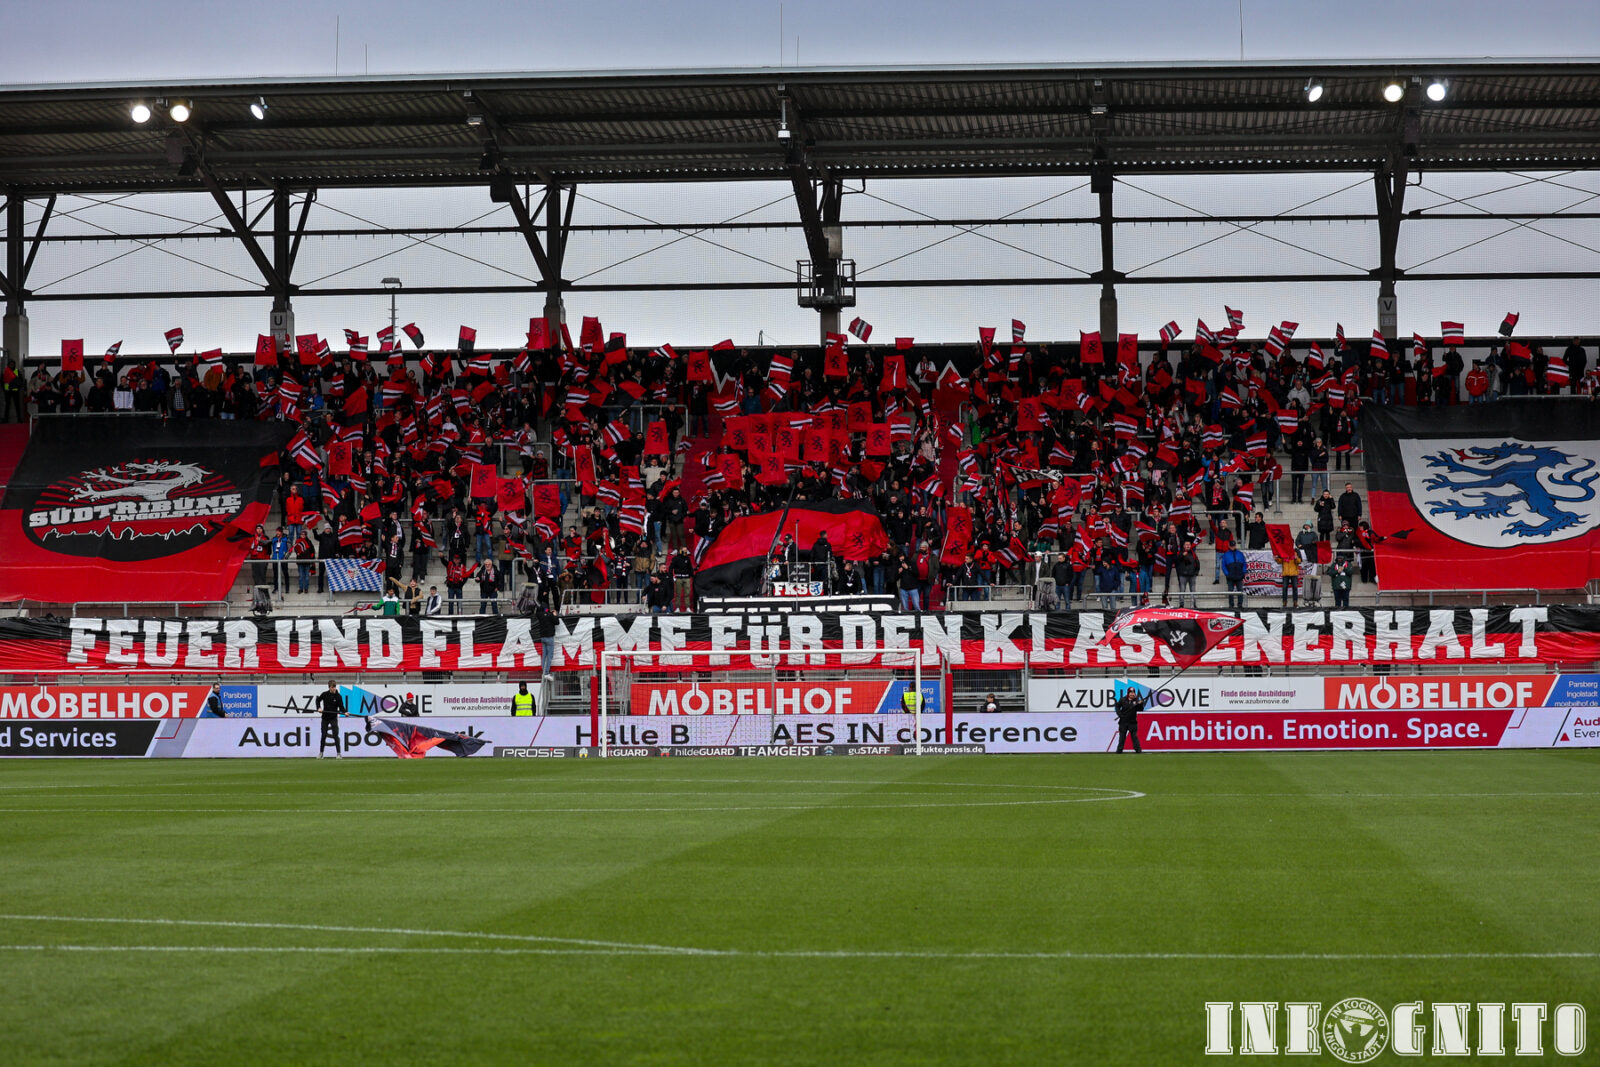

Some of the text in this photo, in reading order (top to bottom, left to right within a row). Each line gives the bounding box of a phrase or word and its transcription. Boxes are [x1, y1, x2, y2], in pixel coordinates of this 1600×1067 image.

[29, 493, 242, 527] SÜDTRIBÜNE
[112, 505, 241, 522] INGOLSTADT
[774, 582, 808, 596] FKS
[67, 617, 260, 669] FEUER
[275, 617, 403, 669] UND
[419, 616, 693, 668] FLAMME
[839, 614, 965, 666] DEN
[980, 607, 1549, 664] KLASNERHALT
[0, 686, 188, 718] MÖBELHOF
[647, 683, 852, 715] MÖBELHOF
[1338, 676, 1533, 709] MÖBELHOF
[222, 702, 252, 710] ngolstadt
[20, 727, 117, 748] Services
[239, 726, 311, 747] Audi
[1146, 718, 1488, 744] Ambition. Emotion. Space.
[675, 746, 735, 757] hildeGUARD
[738, 746, 818, 757] TEAMGEIST
